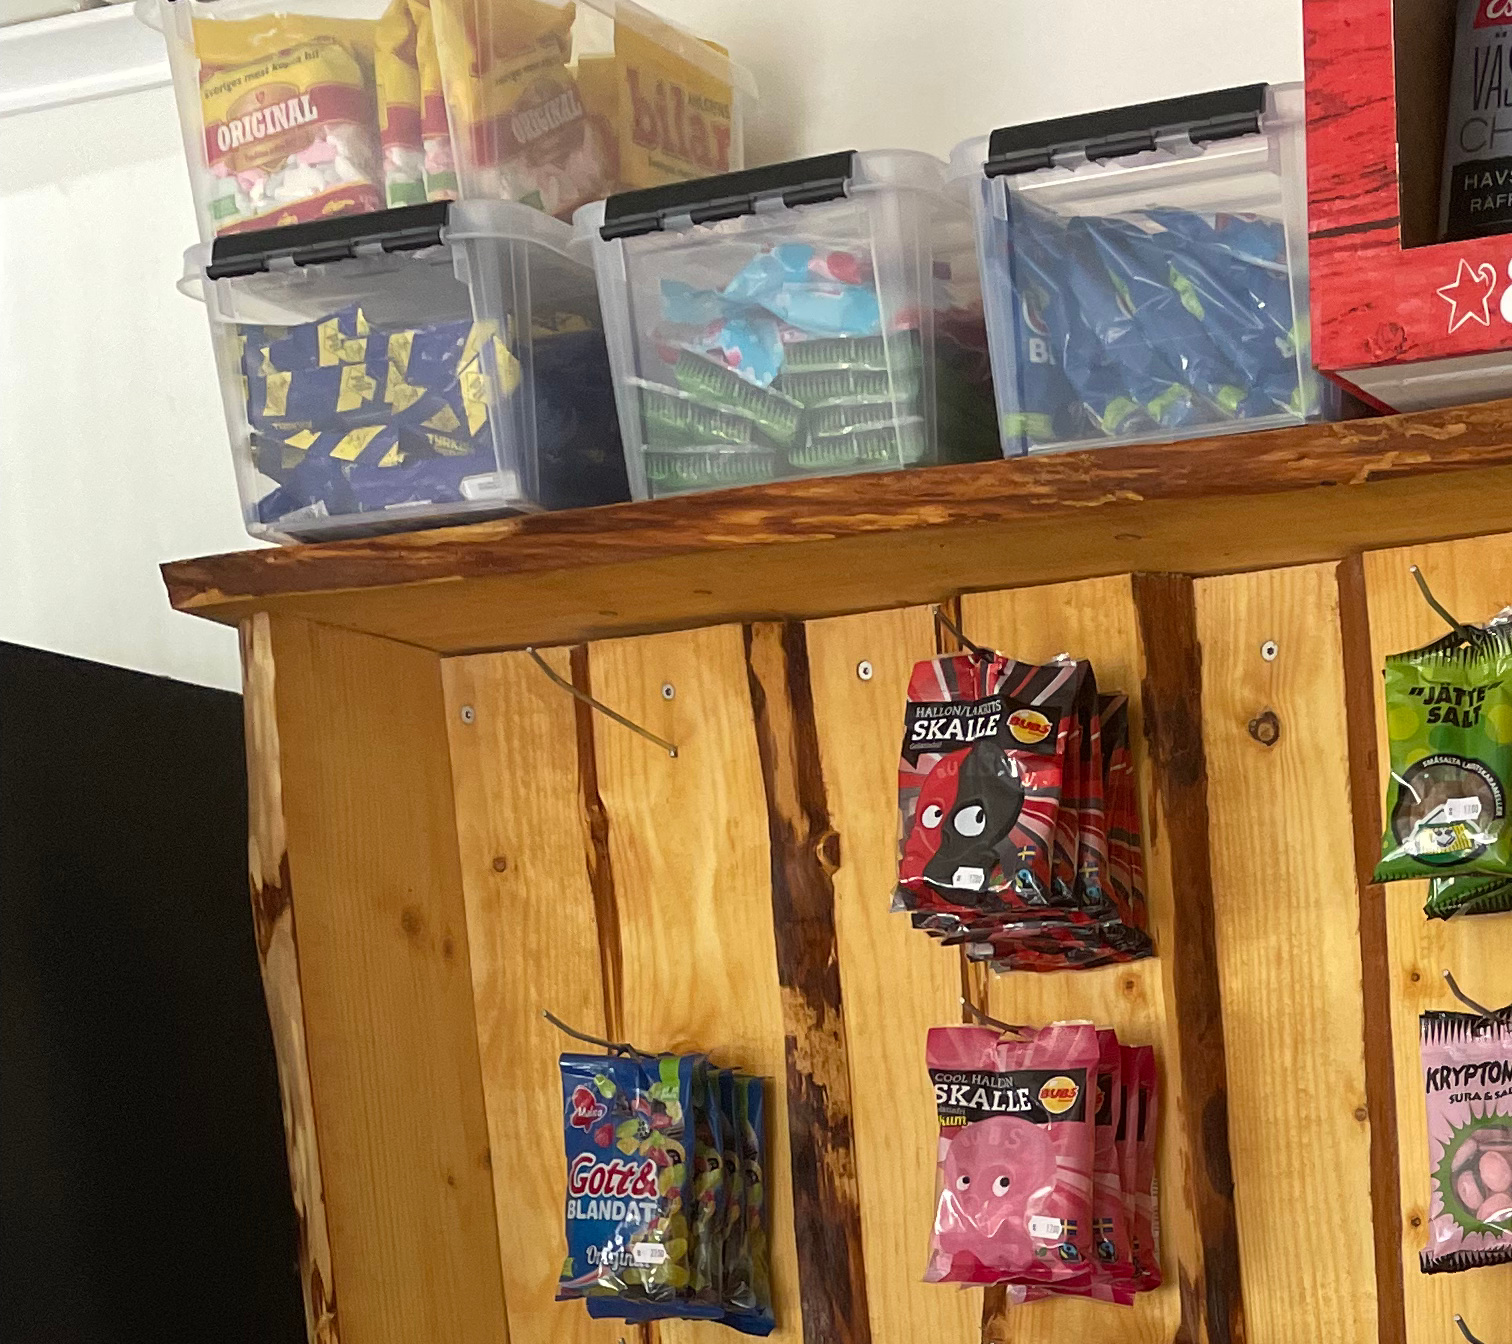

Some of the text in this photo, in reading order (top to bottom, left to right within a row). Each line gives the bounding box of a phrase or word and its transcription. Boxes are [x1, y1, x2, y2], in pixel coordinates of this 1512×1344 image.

[216, 94, 319, 152] ORIGINAL
[1008, 715, 1053, 737] BUBS
[1426, 705, 1483, 729] SALT
[934, 1072, 969, 1085] COOL
[934, 1084, 1080, 1113] SKALLE BUBS
[1449, 1090, 1483, 1104] SURA
[1484, 1091, 1494, 1101] &
[568, 1151, 661, 1199] Gott&
[566, 1198, 659, 1224] BLANDAT
